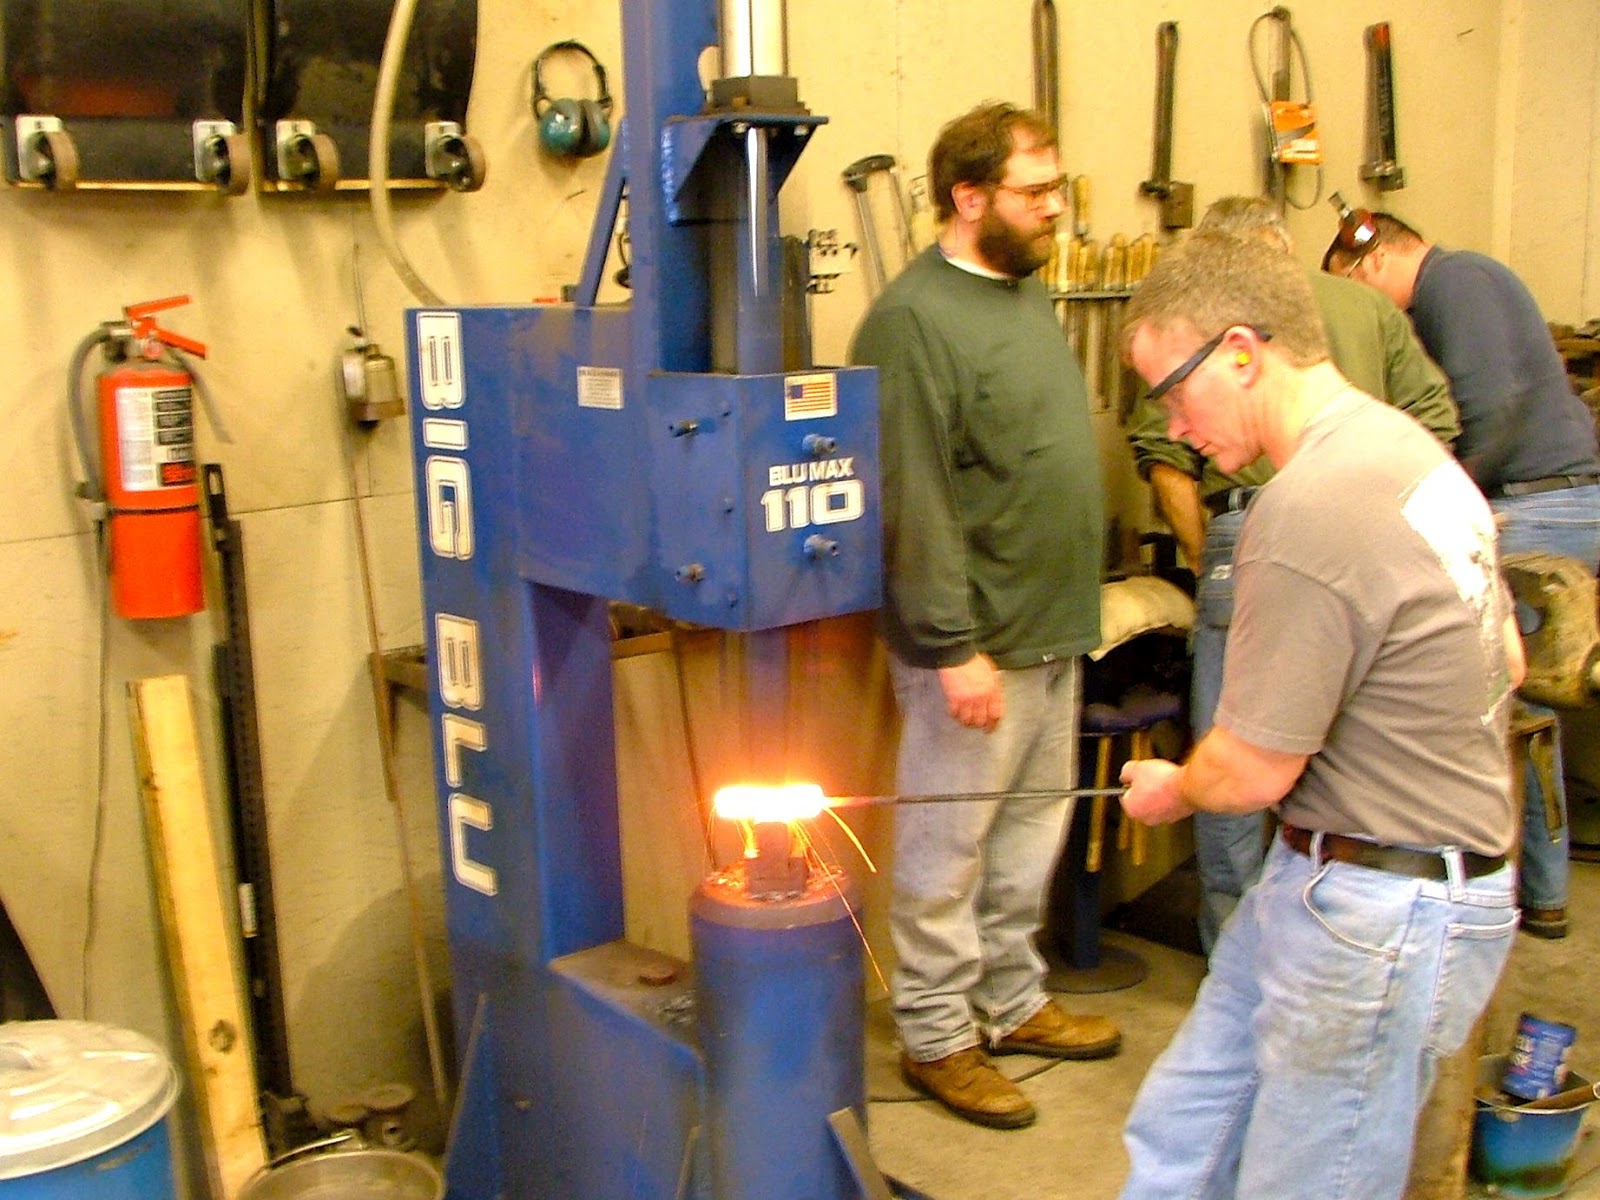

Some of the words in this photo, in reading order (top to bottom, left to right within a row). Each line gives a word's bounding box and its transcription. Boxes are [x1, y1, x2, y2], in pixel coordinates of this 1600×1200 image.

[416, 311, 475, 561] BIG
[761, 479, 865, 532] 110
[769, 463, 808, 486] BLU
[809, 457, 854, 481] MAX
[435, 612, 498, 897] BLU
